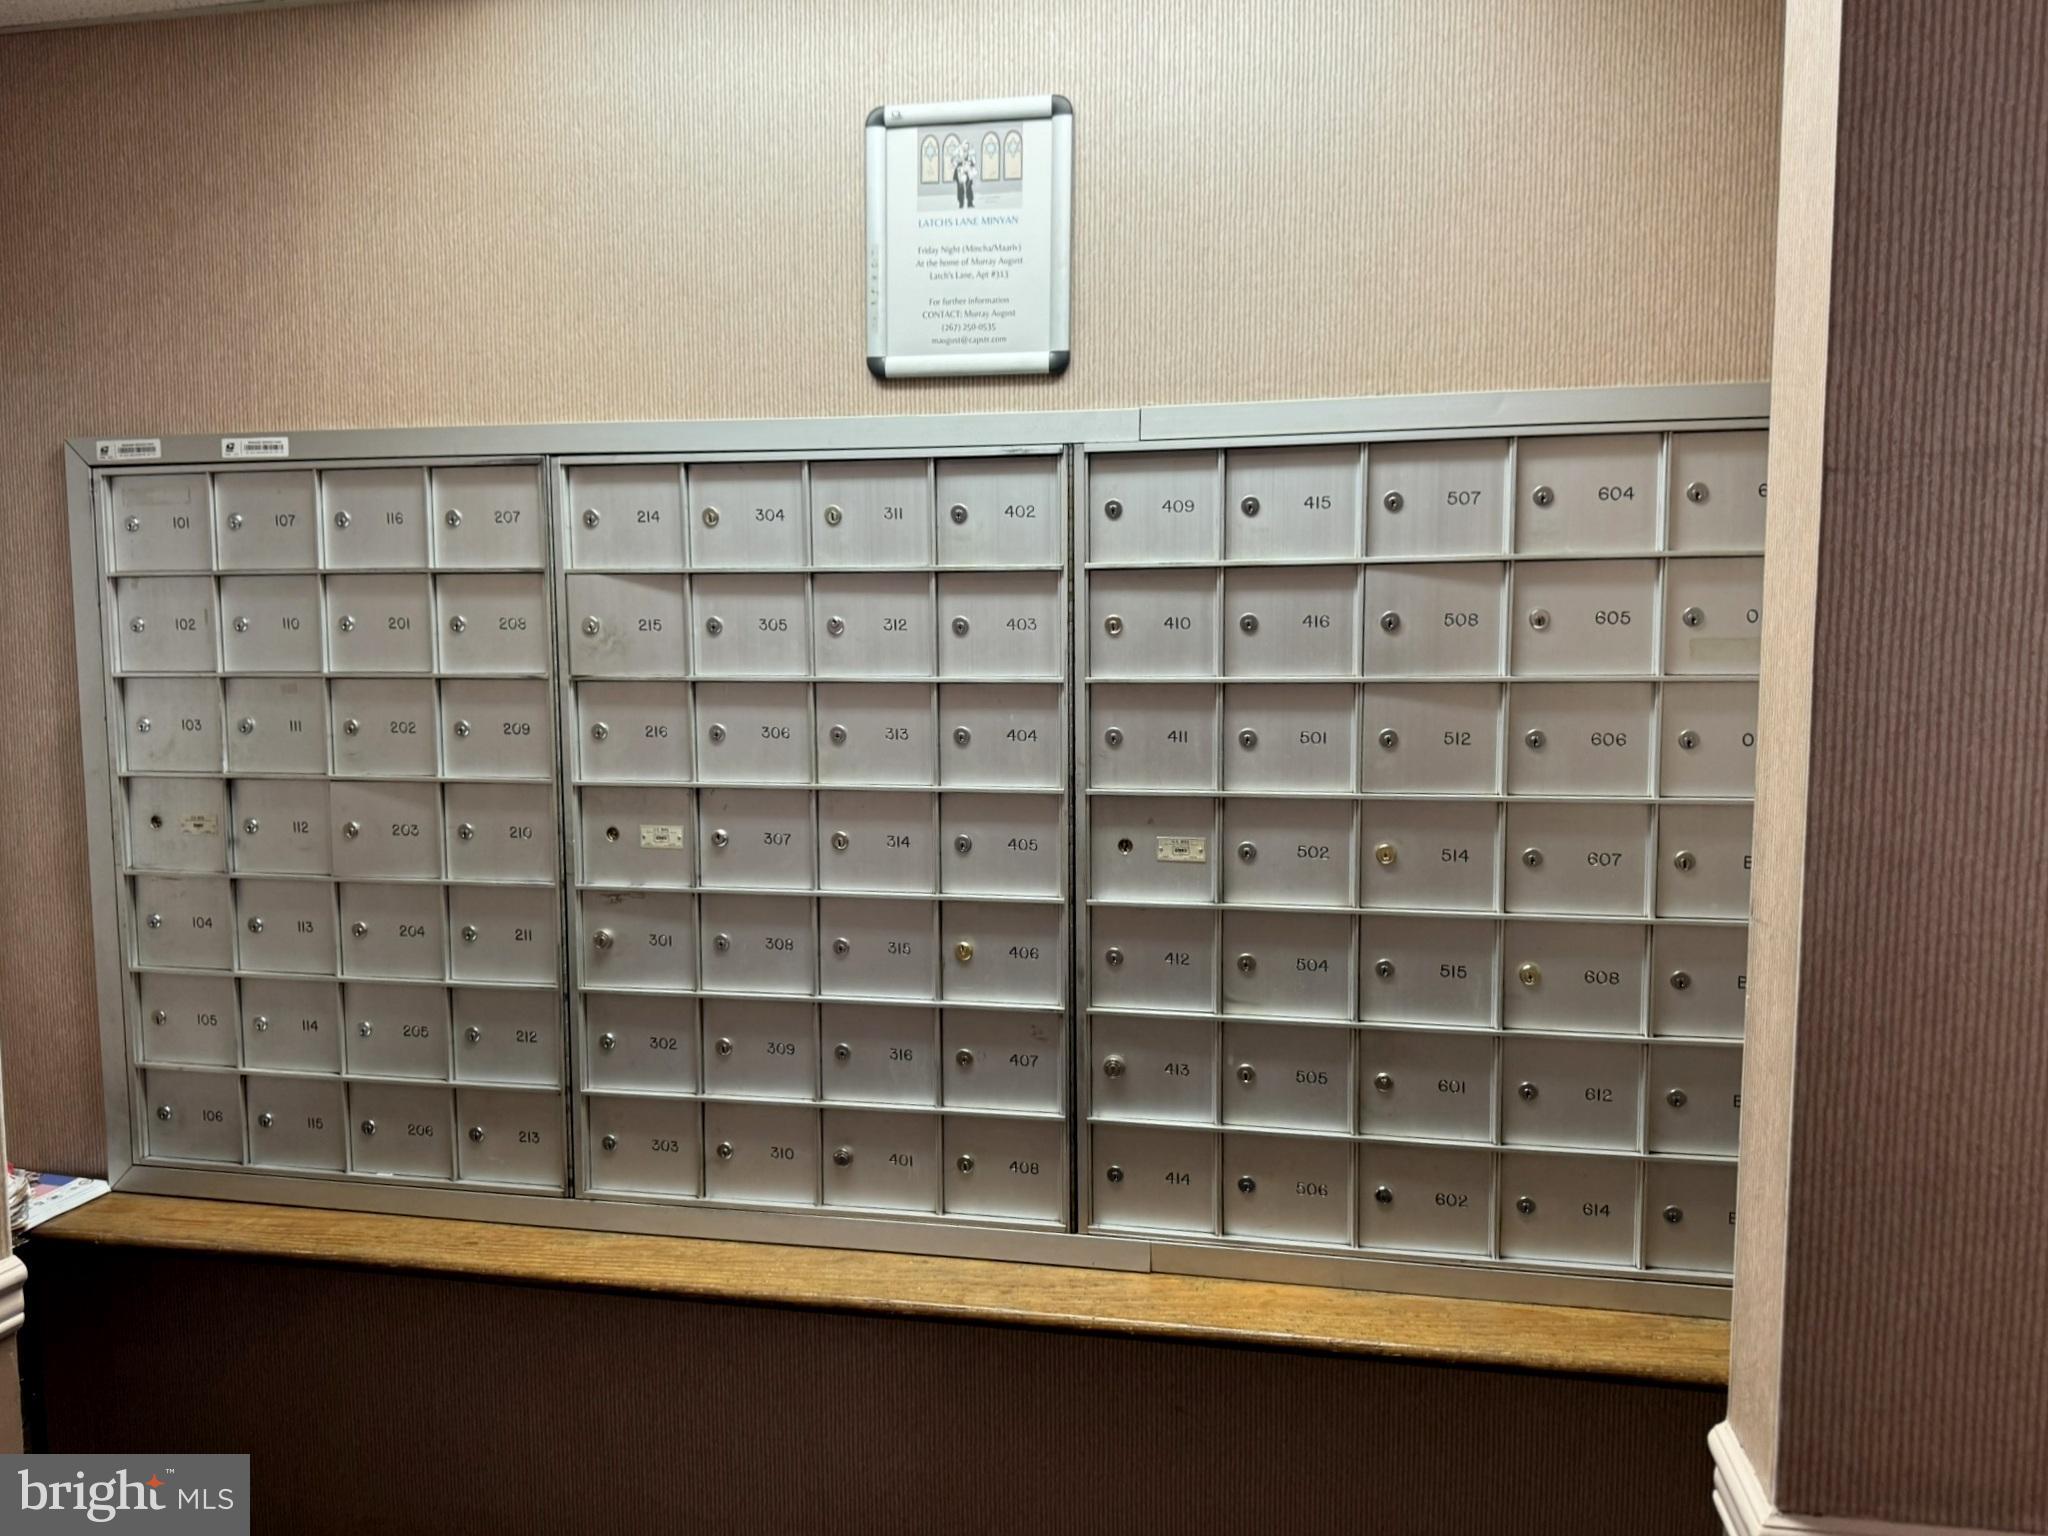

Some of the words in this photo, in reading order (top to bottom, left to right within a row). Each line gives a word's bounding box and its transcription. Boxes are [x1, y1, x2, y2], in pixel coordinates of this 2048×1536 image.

[956, 217, 977, 227] LANE
[981, 216, 1019, 226] MINYAN
[918, 246, 939, 255] Friday
[940, 246, 960, 255] Night
[940, 259, 959, 267] home
[971, 259, 996, 267] Murray
[998, 258, 1023, 267] August
[976, 271, 989, 280] Apt
[929, 298, 941, 306] For
[942, 297, 966, 305] further
[968, 296, 1009, 305] information
[964, 310, 989, 319] Murray
[991, 309, 1016, 317] August
[1446, 490, 1482, 506] 507
[1597, 486, 1635, 502] 604
[1161, 499, 1195, 514] 409
[1303, 495, 1332, 510] 415
[386, 511, 404, 525] 116
[494, 510, 521, 524] 207
[636, 509, 660, 524] 214
[755, 508, 785, 522] 304
[883, 506, 903, 520] 311
[1003, 504, 1036, 519] 402
[172, 516, 190, 529] 101
[275, 513, 296, 527] 107
[174, 618, 197, 632] 102
[282, 617, 300, 631] 110
[388, 616, 410, 630] 201
[498, 616, 527, 631] 208
[638, 618, 663, 632] 215
[758, 617, 788, 632] 305
[883, 617, 908, 632] 312
[1006, 617, 1038, 631] 403
[1163, 616, 1191, 630] 410
[1301, 614, 1330, 629] 416
[1443, 612, 1479, 628] 508
[1594, 610, 1632, 626] 605
[181, 718, 202, 732] 103
[289, 719, 302, 732] 111
[390, 720, 417, 735] 202
[503, 722, 531, 736] 209
[644, 724, 668, 739] 216
[761, 725, 791, 740] 306
[884, 727, 909, 741] 313
[1005, 728, 1038, 743] 404
[1167, 730, 1188, 744] 411
[1299, 730, 1327, 745] 501
[1443, 731, 1472, 746] 512
[1590, 731, 1627, 748] 606
[292, 821, 309, 834] 112
[391, 823, 420, 837] 203
[509, 825, 533, 839] 210
[763, 832, 792, 846] 307
[886, 835, 911, 849] 314
[1007, 838, 1038, 852] 405
[1296, 844, 1329, 859] 502
[1441, 848, 1469, 863] 514
[1587, 851, 1623, 867] 607
[192, 916, 213, 929] 104
[297, 920, 314, 933] 113
[399, 924, 425, 938] 204
[514, 928, 532, 942] 211
[648, 933, 673, 947] 301
[765, 937, 794, 951] 308
[887, 941, 912, 955] 315
[1008, 946, 1040, 960] 406
[1164, 952, 1190, 966] 412
[1296, 958, 1329, 973] 504
[1439, 964, 1468, 980] 515
[1584, 969, 1620, 985] 608
[197, 1014, 218, 1026] 105
[302, 1019, 319, 1032] 114
[403, 1024, 429, 1038] 205
[516, 1030, 537, 1044] 212
[649, 1036, 678, 1050] 302
[767, 1042, 796, 1056] 309
[889, 1047, 913, 1062] 316
[1009, 1053, 1039, 1068] 407
[1164, 1062, 1190, 1077] 413
[1295, 1070, 1328, 1085] 505
[1437, 1079, 1466, 1094] 601
[1584, 1087, 1613, 1103] 612
[202, 1110, 223, 1122] 106
[307, 1117, 324, 1130] 115
[407, 1123, 434, 1137] 206
[518, 1130, 540, 1144] 213
[651, 1139, 679, 1153] 303
[770, 1146, 795, 1161] 310
[888, 1153, 913, 1167] 401
[1009, 1160, 1040, 1175] 408
[1165, 1171, 1190, 1186] 414
[1295, 1183, 1328, 1197] 506
[1435, 1193, 1468, 1208] 602
[1582, 1203, 1610, 1218] 614
